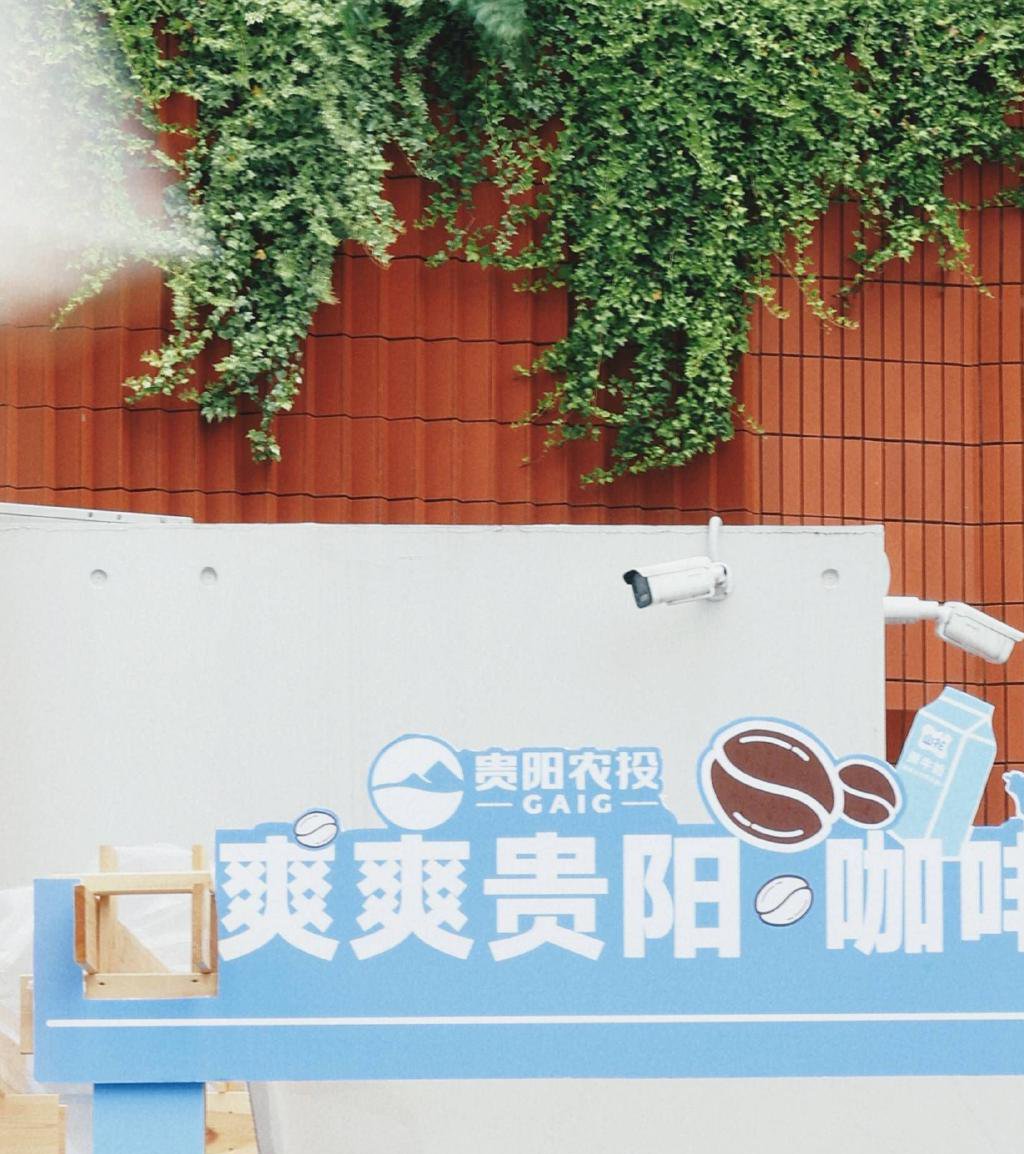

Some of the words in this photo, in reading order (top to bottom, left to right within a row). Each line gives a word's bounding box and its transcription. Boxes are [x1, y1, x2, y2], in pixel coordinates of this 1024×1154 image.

[474, 750, 660, 790] 贵阳农投
[523, 795, 613, 814] GAIG
[218, 832, 741, 961] 爽爽贵阳
